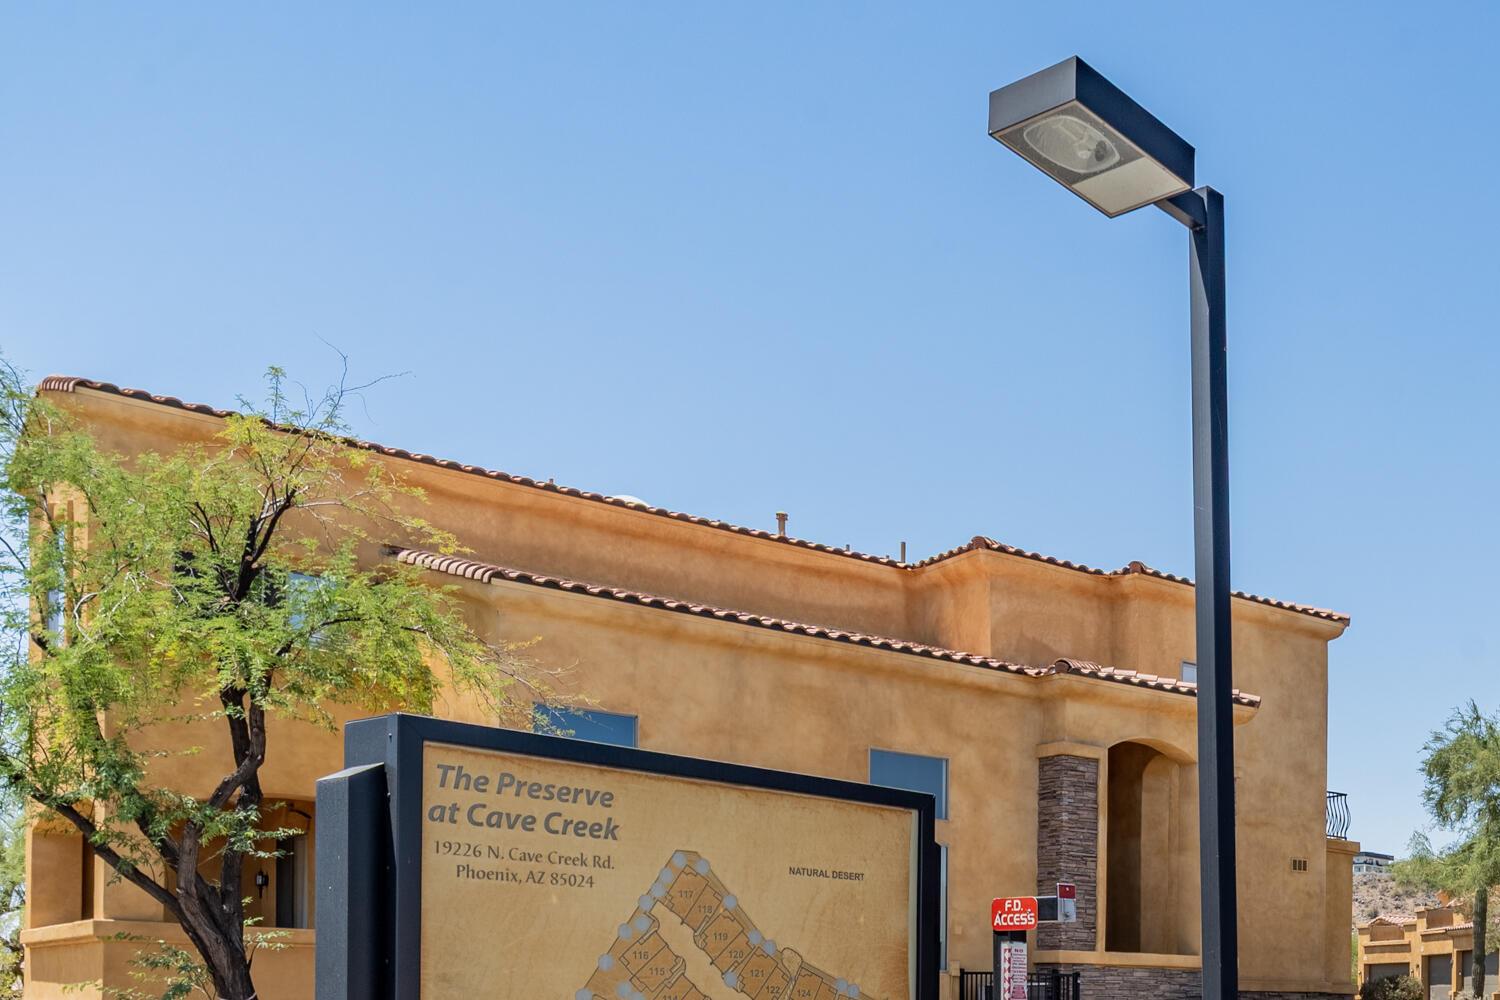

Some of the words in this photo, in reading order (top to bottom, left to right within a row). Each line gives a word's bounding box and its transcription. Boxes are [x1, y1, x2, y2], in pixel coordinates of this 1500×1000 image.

[437, 764, 489, 792] The
[496, 772, 614, 808] Preserve
[428, 802, 460, 824] at
[467, 803, 537, 832] Cave
[544, 812, 620, 840] Creek
[435, 840, 482, 858] 19226
[488, 846, 504, 859] N.
[508, 848, 543, 863] Cave
[548, 851, 588, 868] Creek
[593, 856, 615, 870] Rd.
[456, 864, 522, 884] Phoenix,
[525, 871, 546, 884] AZ
[550, 873, 595, 888] 85024
[789, 867, 830, 878] NATURAL
[832, 871, 864, 880] DESERT
[679, 890, 693, 898] 117
[1005, 900, 1023, 911] F.D.
[994, 913, 1035, 926] ACCESS
[713, 932, 728, 941] 119
[729, 951, 744, 959] 120
[750, 969, 764, 978] 121
[766, 986, 780, 994] 122
[797, 989, 811, 998] 124
